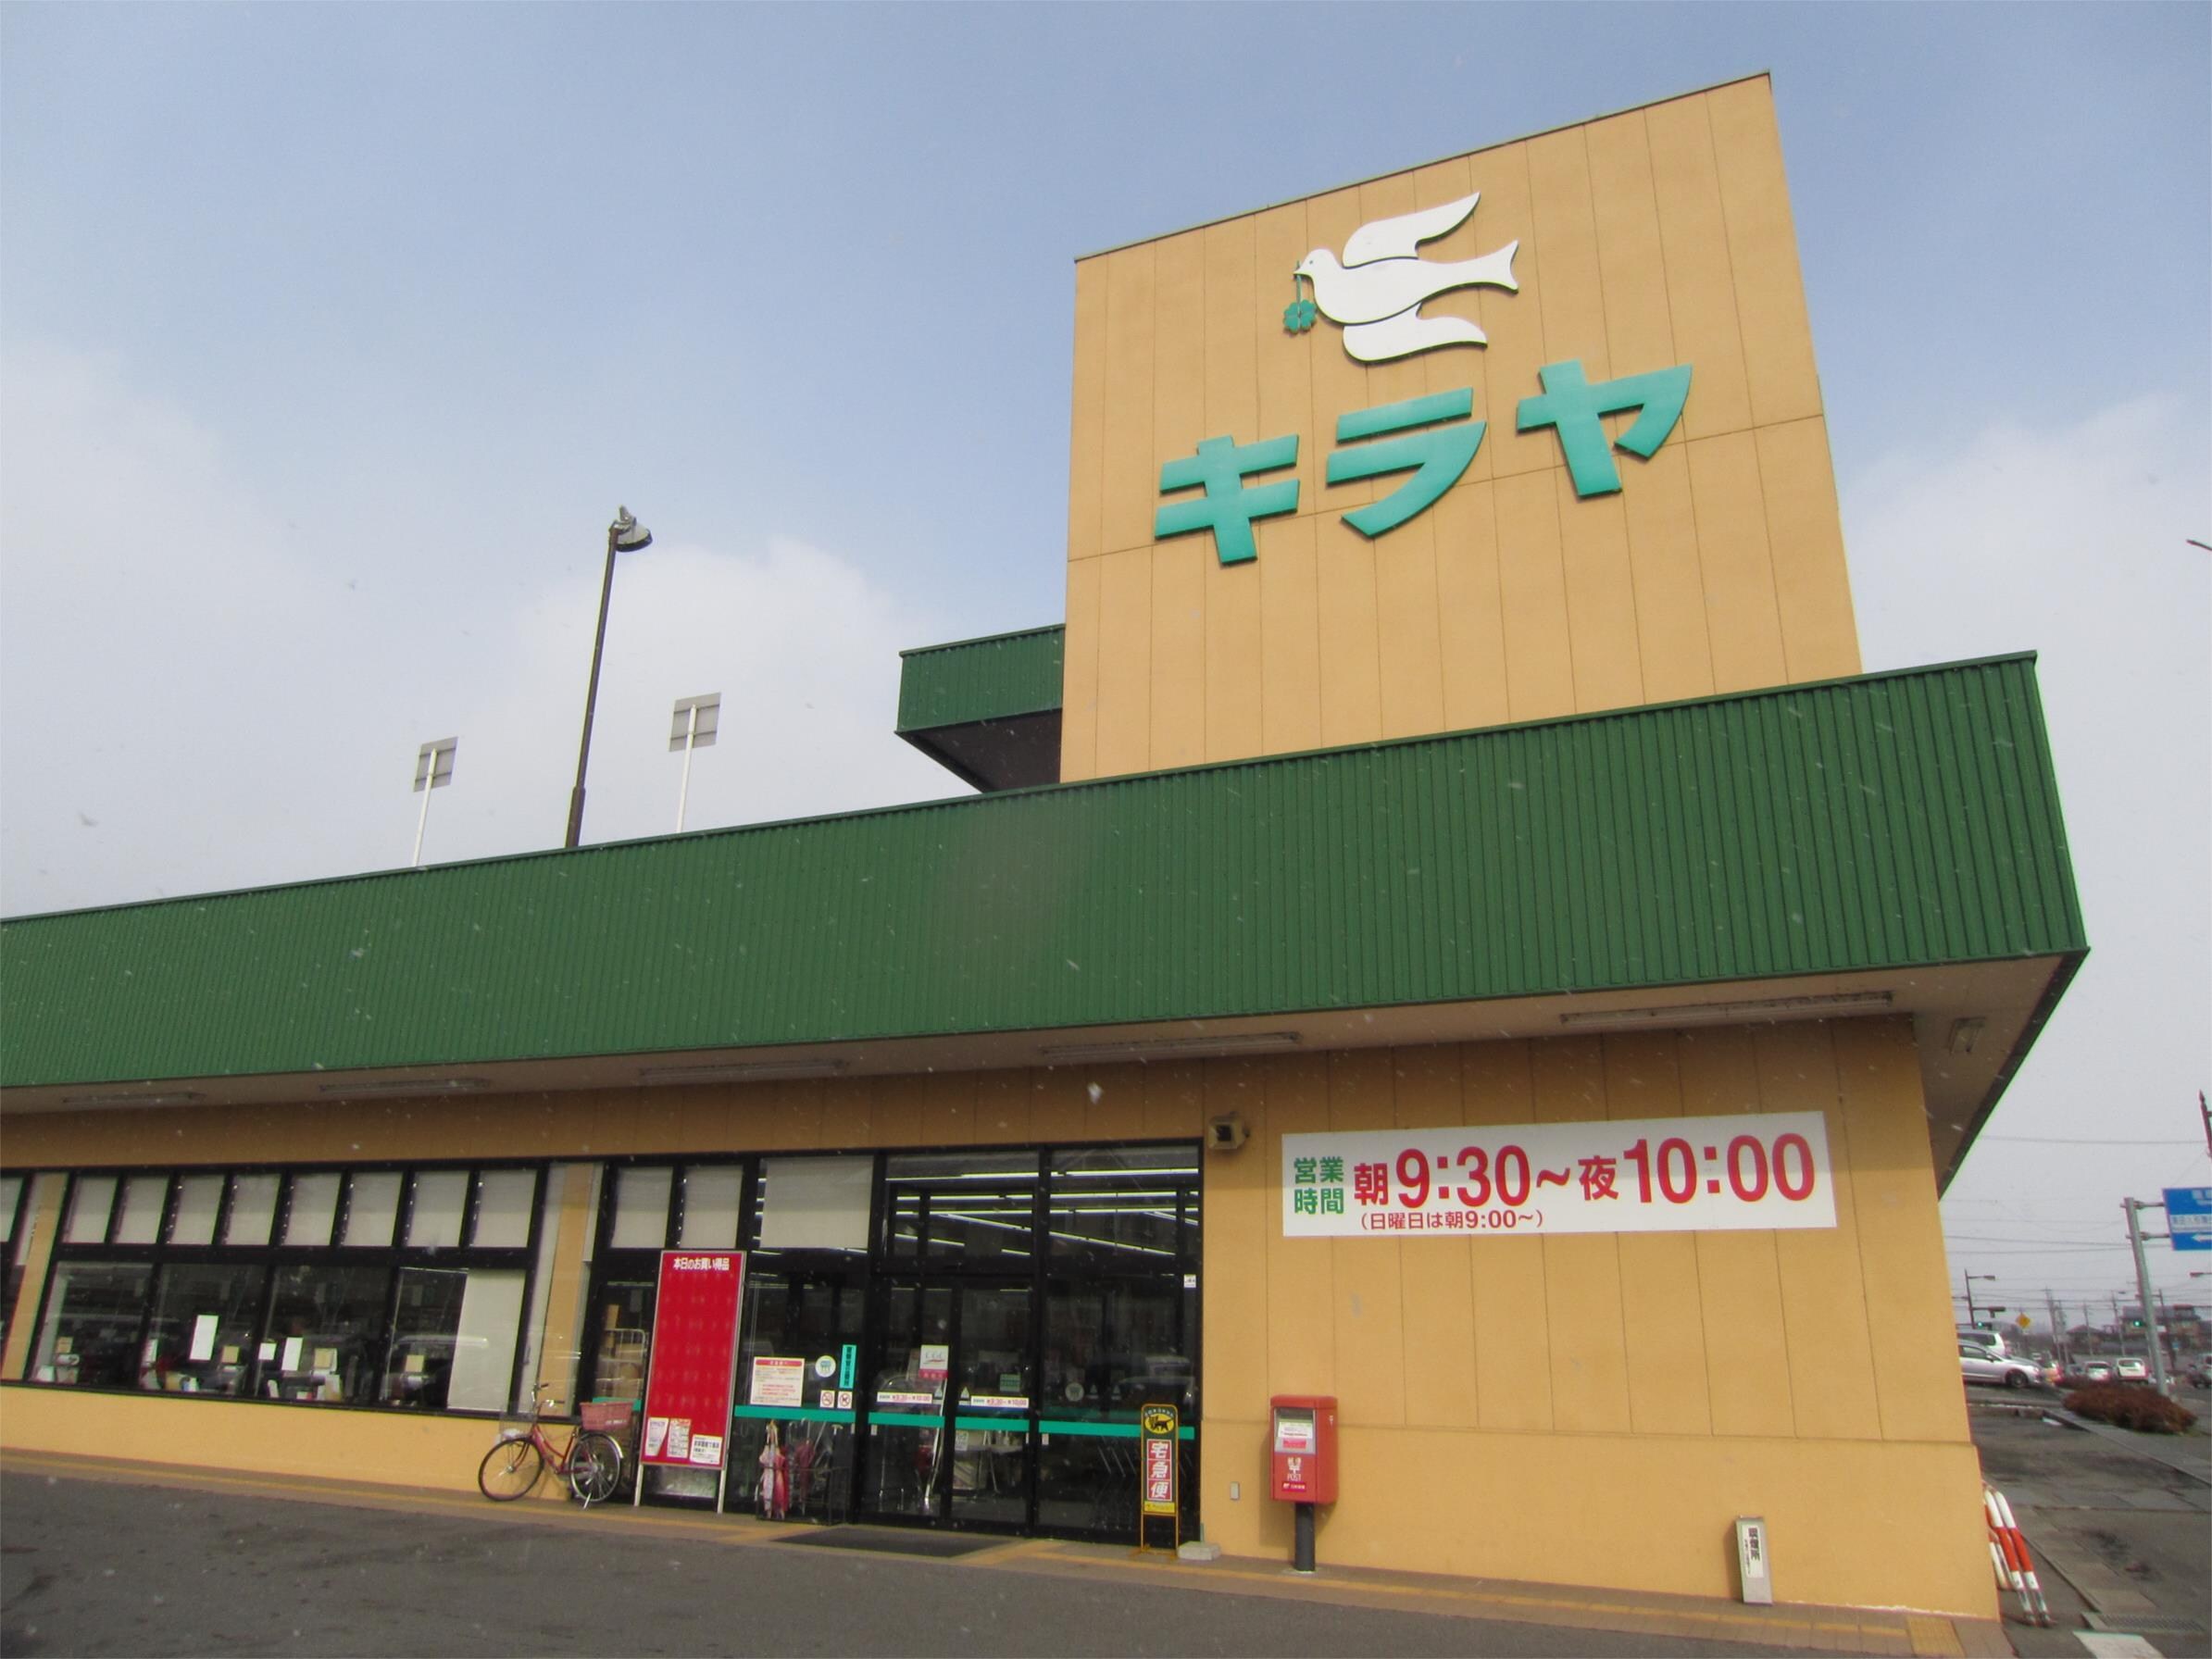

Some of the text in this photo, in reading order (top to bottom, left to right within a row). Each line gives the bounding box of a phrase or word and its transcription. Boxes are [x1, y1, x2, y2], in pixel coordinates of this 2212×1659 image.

[1155, 359, 1693, 567] キラヤ
[1293, 1156, 1344, 1184] 営業
[1293, 1187, 1344, 1216] 時間
[1150, 1441, 1169, 1498] 宅急便
